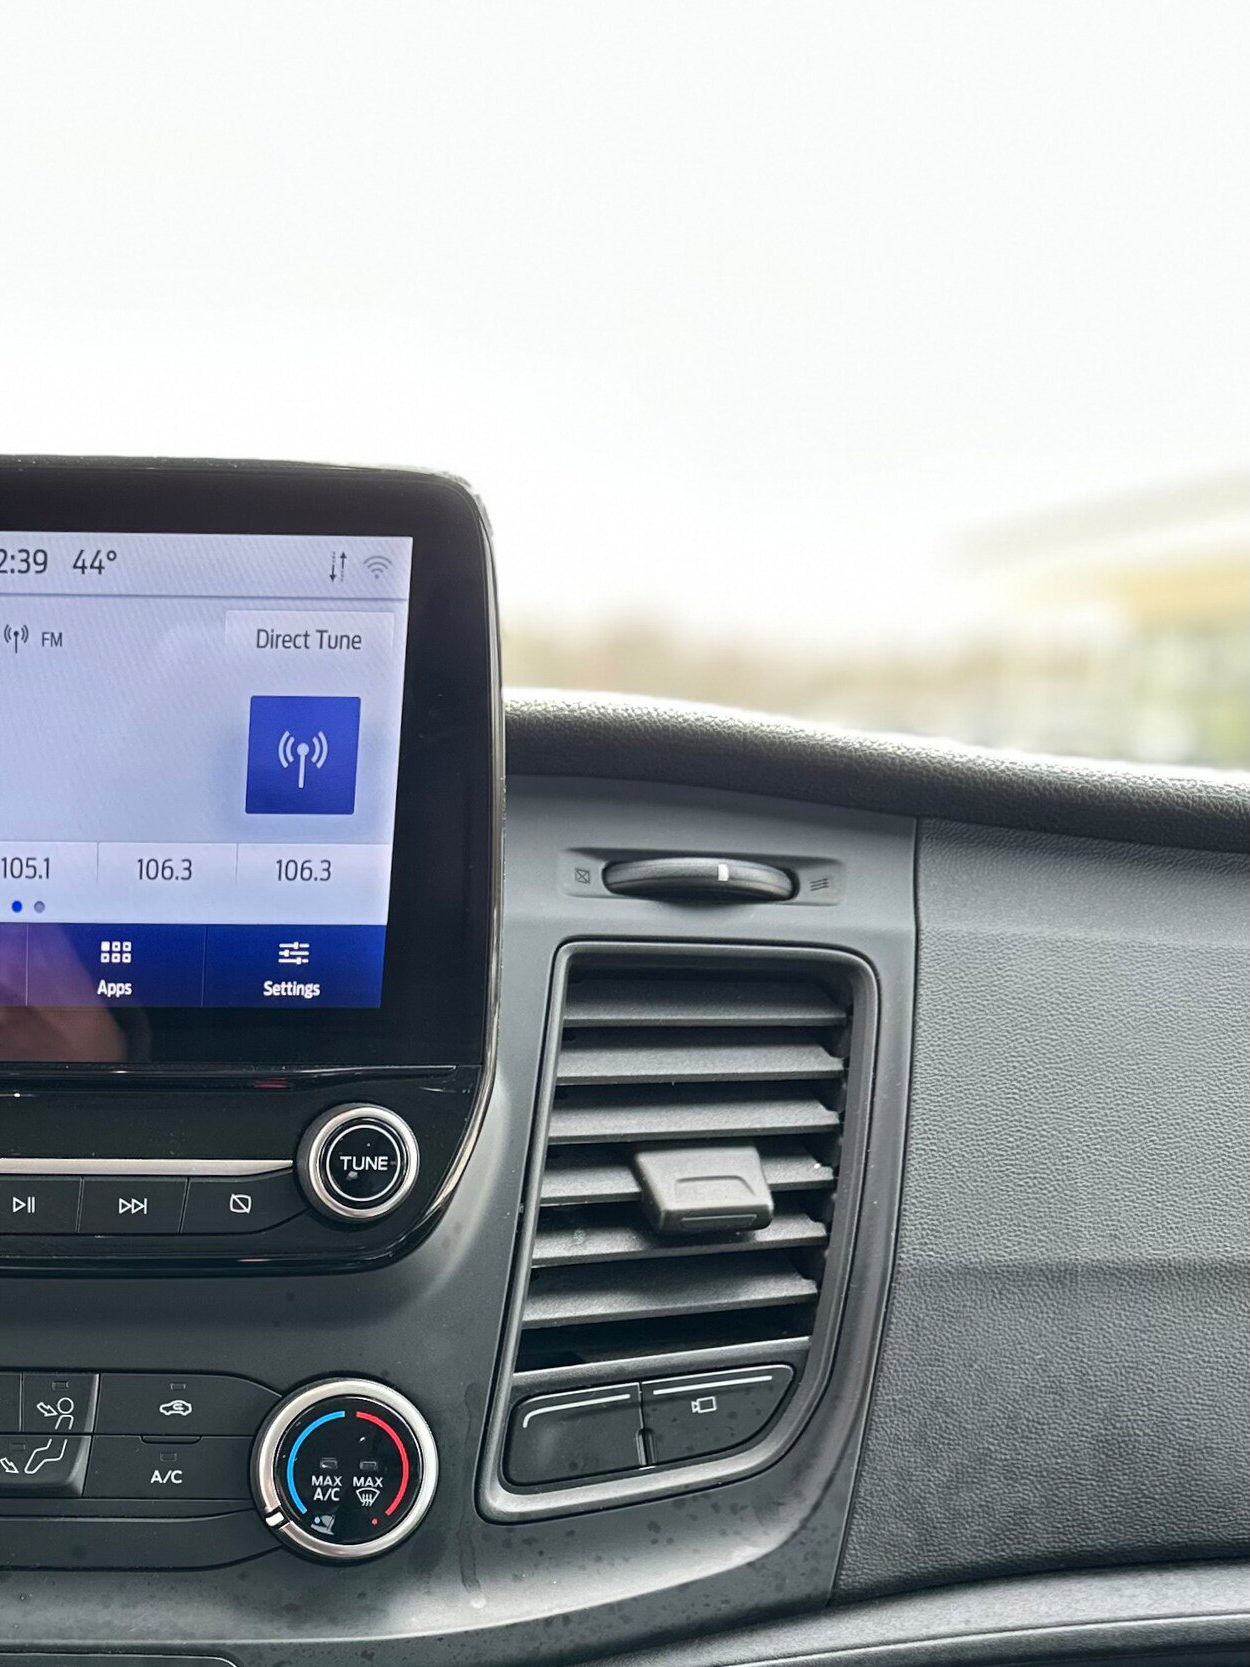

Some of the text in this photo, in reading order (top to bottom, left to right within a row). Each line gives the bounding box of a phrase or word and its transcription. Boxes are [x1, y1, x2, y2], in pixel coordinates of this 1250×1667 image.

[72, 549, 118, 575] 44°
[41, 631, 63, 648] FM
[256, 628, 362, 651] Direct Tune
[1, 856, 51, 880] 105.1
[136, 858, 193, 881] 106.3
[275, 859, 333, 883] 106.3
[96, 979, 133, 998] Apps
[263, 980, 321, 998] Settings
[339, 1156, 389, 1172] TUNE
[150, 1469, 183, 1484] A/C
[311, 1475, 343, 1487] MAX
[352, 1476, 384, 1488] MAX
[313, 1488, 340, 1501] A/C
